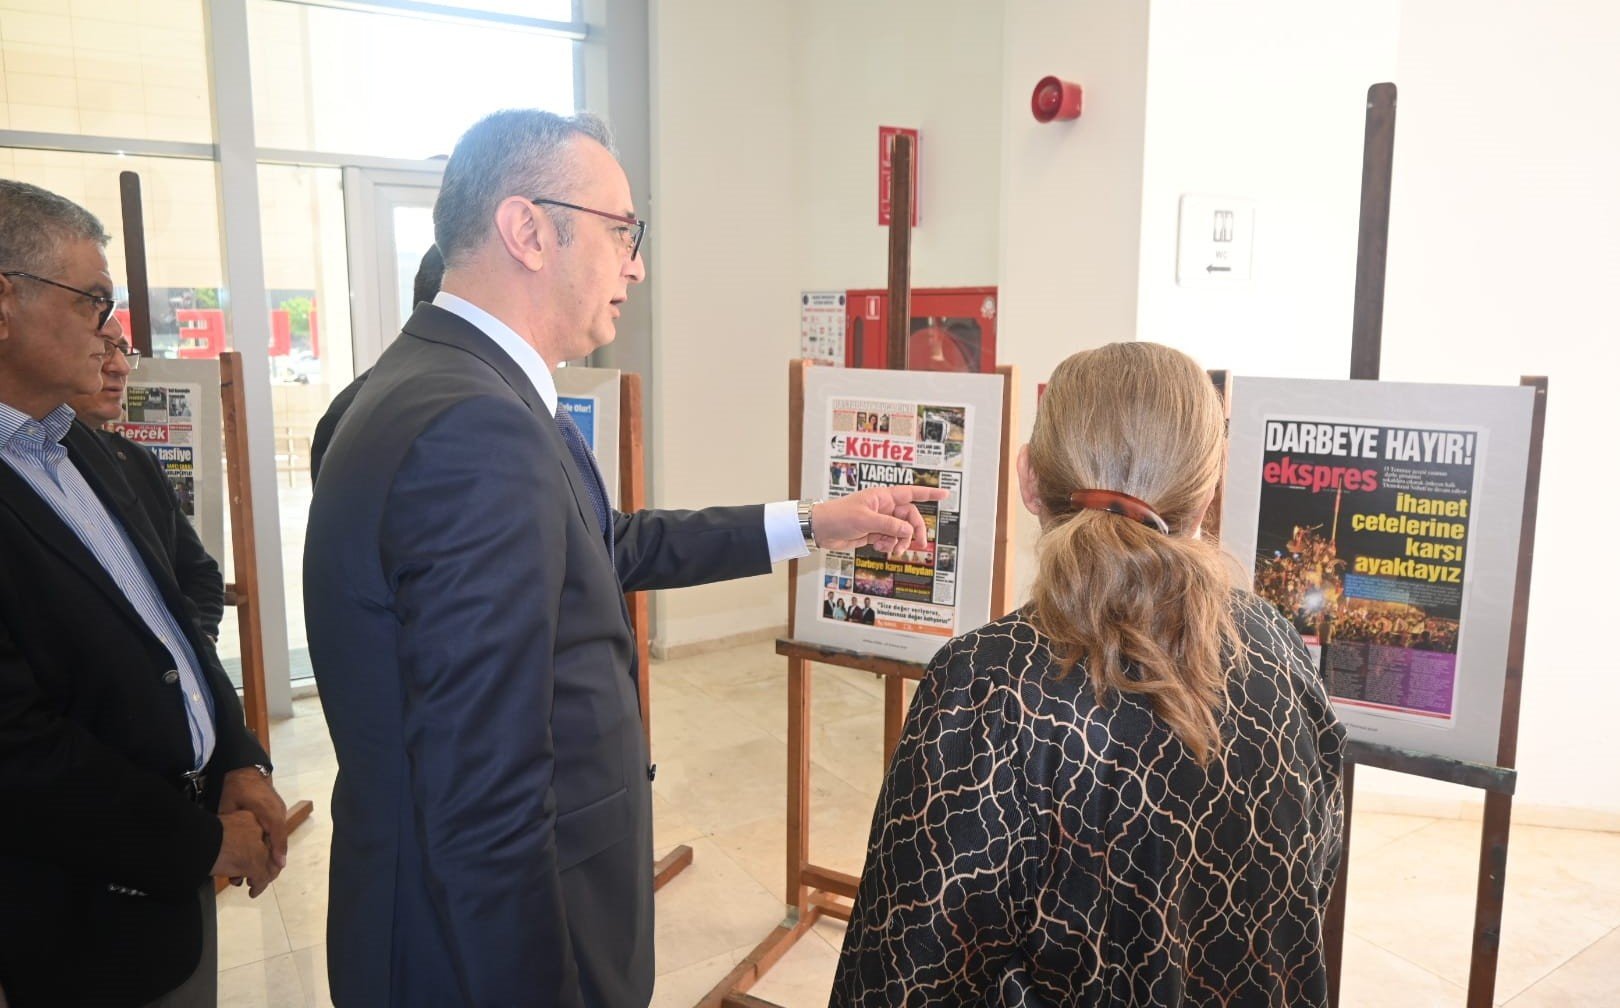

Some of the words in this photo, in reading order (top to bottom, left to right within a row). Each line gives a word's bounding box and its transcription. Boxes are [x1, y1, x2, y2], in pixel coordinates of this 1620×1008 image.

[159, 446, 192, 462] tasfiye
[845, 436, 914, 462] Körfez
[1266, 422, 1380, 459] DARBEYE
[1385, 429, 1474, 466] HAYIR!
[860, 463, 915, 485] YARGIYA
[1263, 456, 1378, 493] ekspres
[1352, 513, 1465, 540] çetelerine
[1405, 537, 1462, 563] karşı
[855, 558, 884, 571] Darbeye
[904, 564, 934, 577] Meydan
[1355, 556, 1461, 583] ayaktayız
